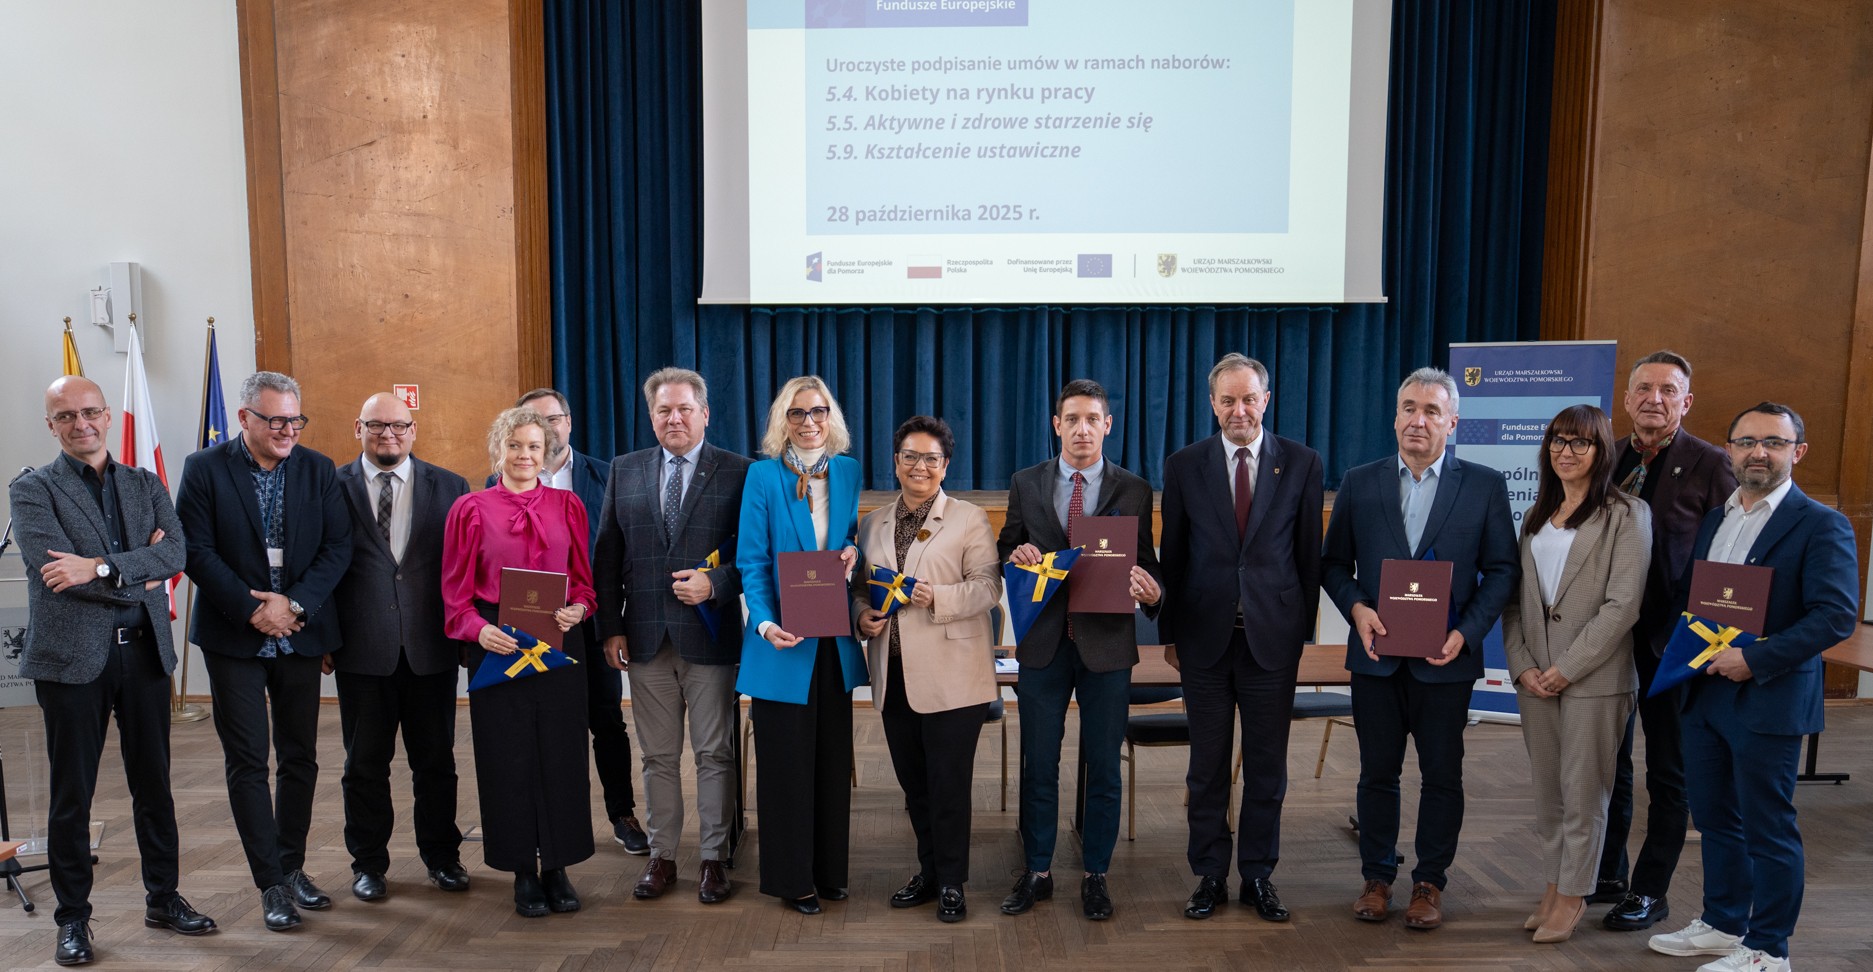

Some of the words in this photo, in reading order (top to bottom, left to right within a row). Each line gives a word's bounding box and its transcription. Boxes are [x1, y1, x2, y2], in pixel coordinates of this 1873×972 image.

[876, 0, 937, 11] Fundusze
[941, 0, 1016, 13] Europejskie
[826, 58, 906, 76] Uroczyste
[911, 56, 1002, 75] podpisanie
[1008, 54, 1060, 71] umów
[1064, 58, 1080, 70] w
[1085, 54, 1146, 71] ramach
[1151, 53, 1231, 70] naborów:
[825, 85, 858, 102] 5.4.
[865, 84, 941, 105] Kobiety
[947, 87, 970, 101] na
[977, 83, 1034, 105] rynku
[1041, 86, 1096, 106] pracy
[825, 115, 858, 132] 5.5.
[863, 114, 946, 135] Aktywne
[951, 113, 958, 130] i
[961, 113, 1029, 130] zdrowe
[1034, 112, 1122, 129] starzenie
[1126, 112, 1154, 134] się
[825, 144, 858, 161] 5.9.
[865, 142, 972, 160] Kształcenie
[977, 141, 1082, 159] ustawiczne
[826, 206, 850, 223] 28
[856, 204, 972, 227] października
[978, 205, 1023, 221] 2025
[1029, 207, 1040, 221] r.
[857, 259, 893, 268] Europejskie
[946, 258, 994, 267] Rzeczpospolita
[1006, 258, 1055, 266] Dofinansowane
[1193, 258, 1216, 266] URZĄD
[1218, 258, 1273, 266] MARSZAŁKOWSKI
[827, 267, 837, 275] dla
[837, 267, 865, 275] Pomorza
[1023, 266, 1038, 275] Unię
[1038, 266, 1073, 275] Europejską
[1180, 266, 1234, 274] WOJEWÓDZTWA
[1234, 266, 1285, 274] POMORSKIEGO
[1494, 369, 1514, 377] URZĄD
[1501, 423, 1539, 431] Fundusze
[1501, 433, 1514, 441] dla
